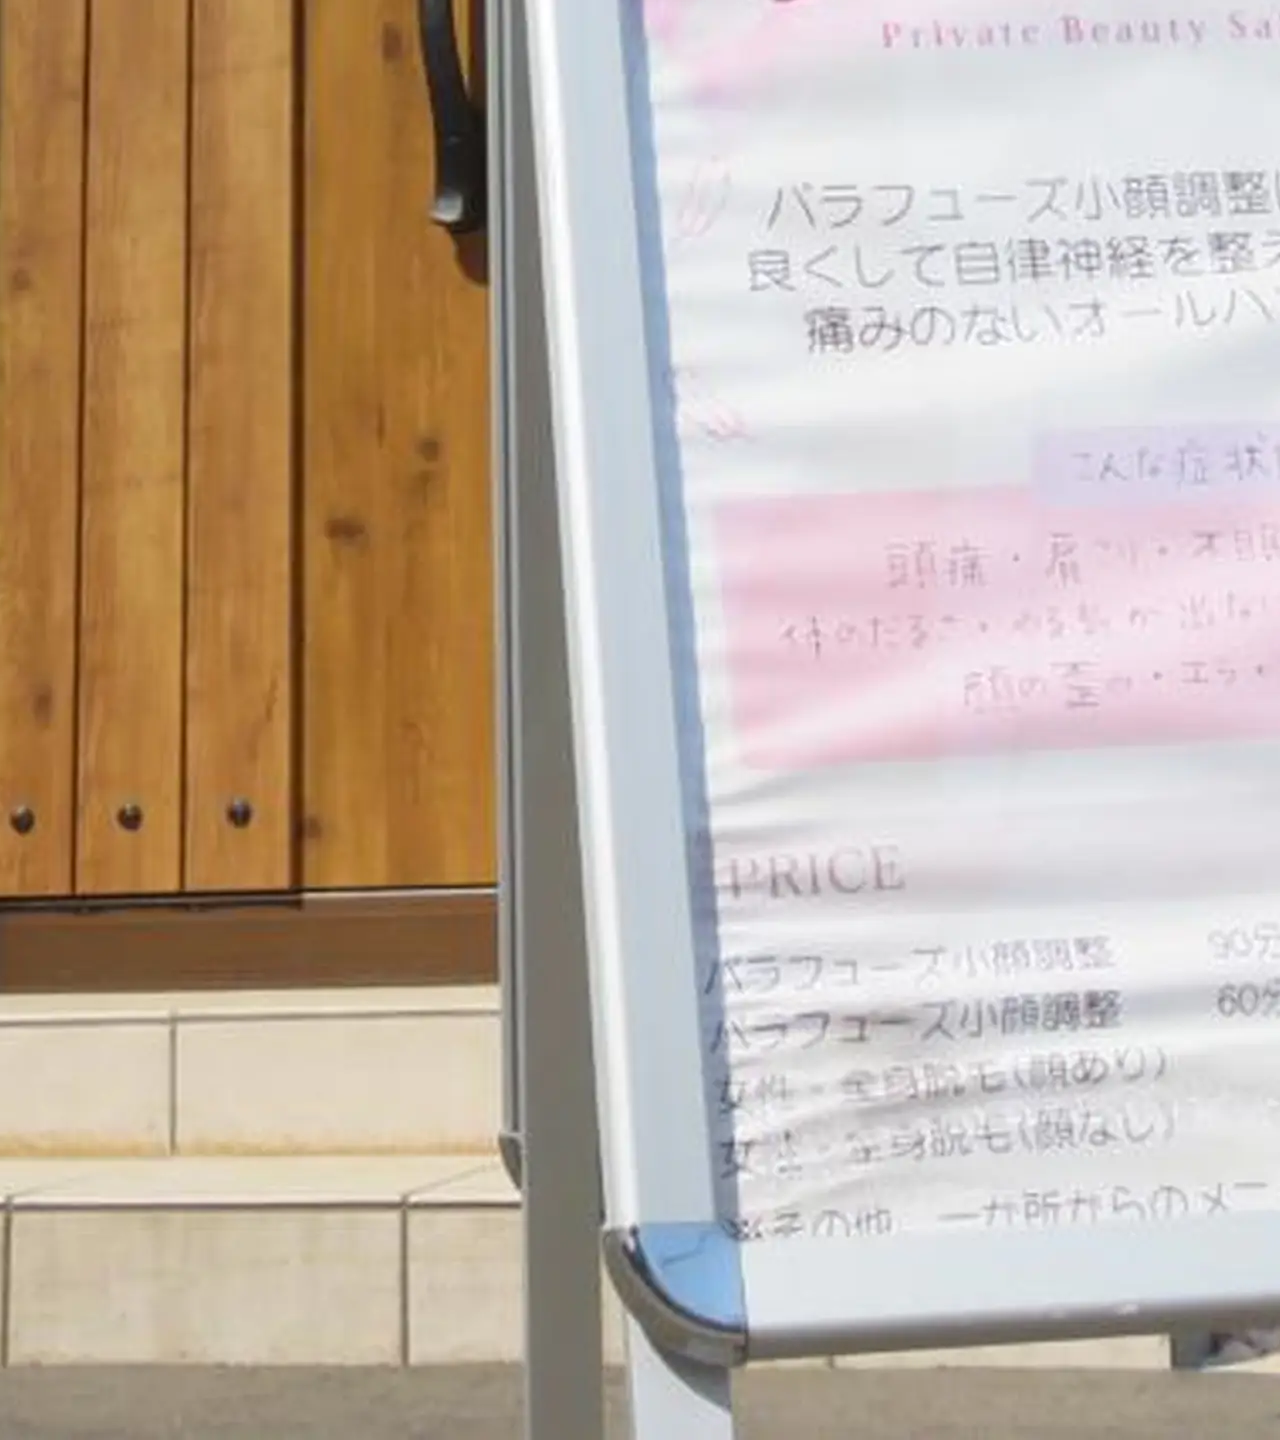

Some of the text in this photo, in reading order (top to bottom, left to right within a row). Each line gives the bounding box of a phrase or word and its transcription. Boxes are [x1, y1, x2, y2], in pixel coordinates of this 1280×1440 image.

[881, 18, 1042, 49] Private
[1059, 14, 1209, 47] Beauty
[726, 843, 907, 901] PRICE
